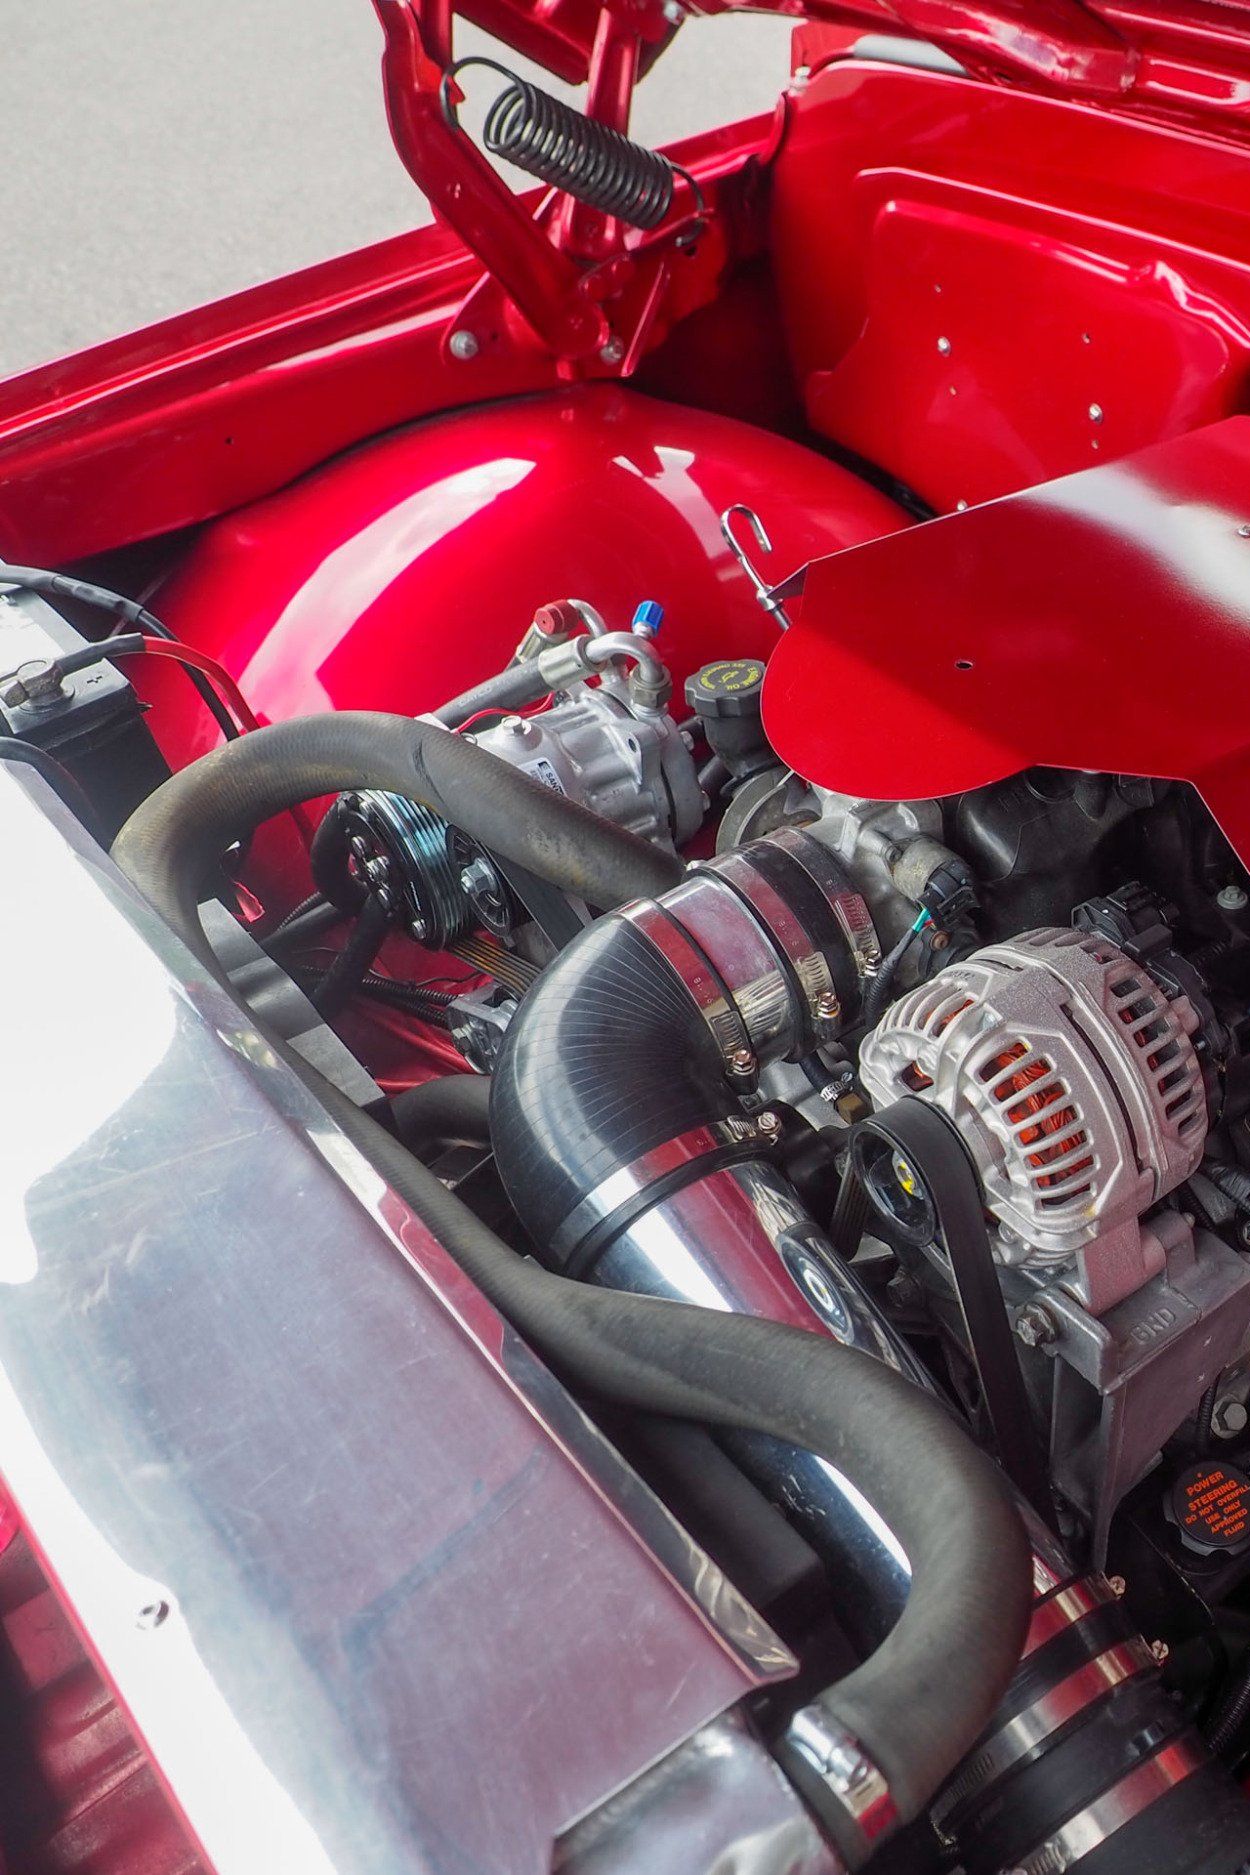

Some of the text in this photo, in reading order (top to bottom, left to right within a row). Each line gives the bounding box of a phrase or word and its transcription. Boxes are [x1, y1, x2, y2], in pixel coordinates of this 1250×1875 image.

[1186, 1471, 1224, 1496] POWER
[1188, 1480, 1237, 1511] STEERING
[1186, 1484, 1250, 1524] DO NOT OVERFILL
[1205, 1500, 1240, 1524] USE ONLY
[1211, 1508, 1247, 1534] APPROVED
[1224, 1521, 1245, 1536] FLUID
